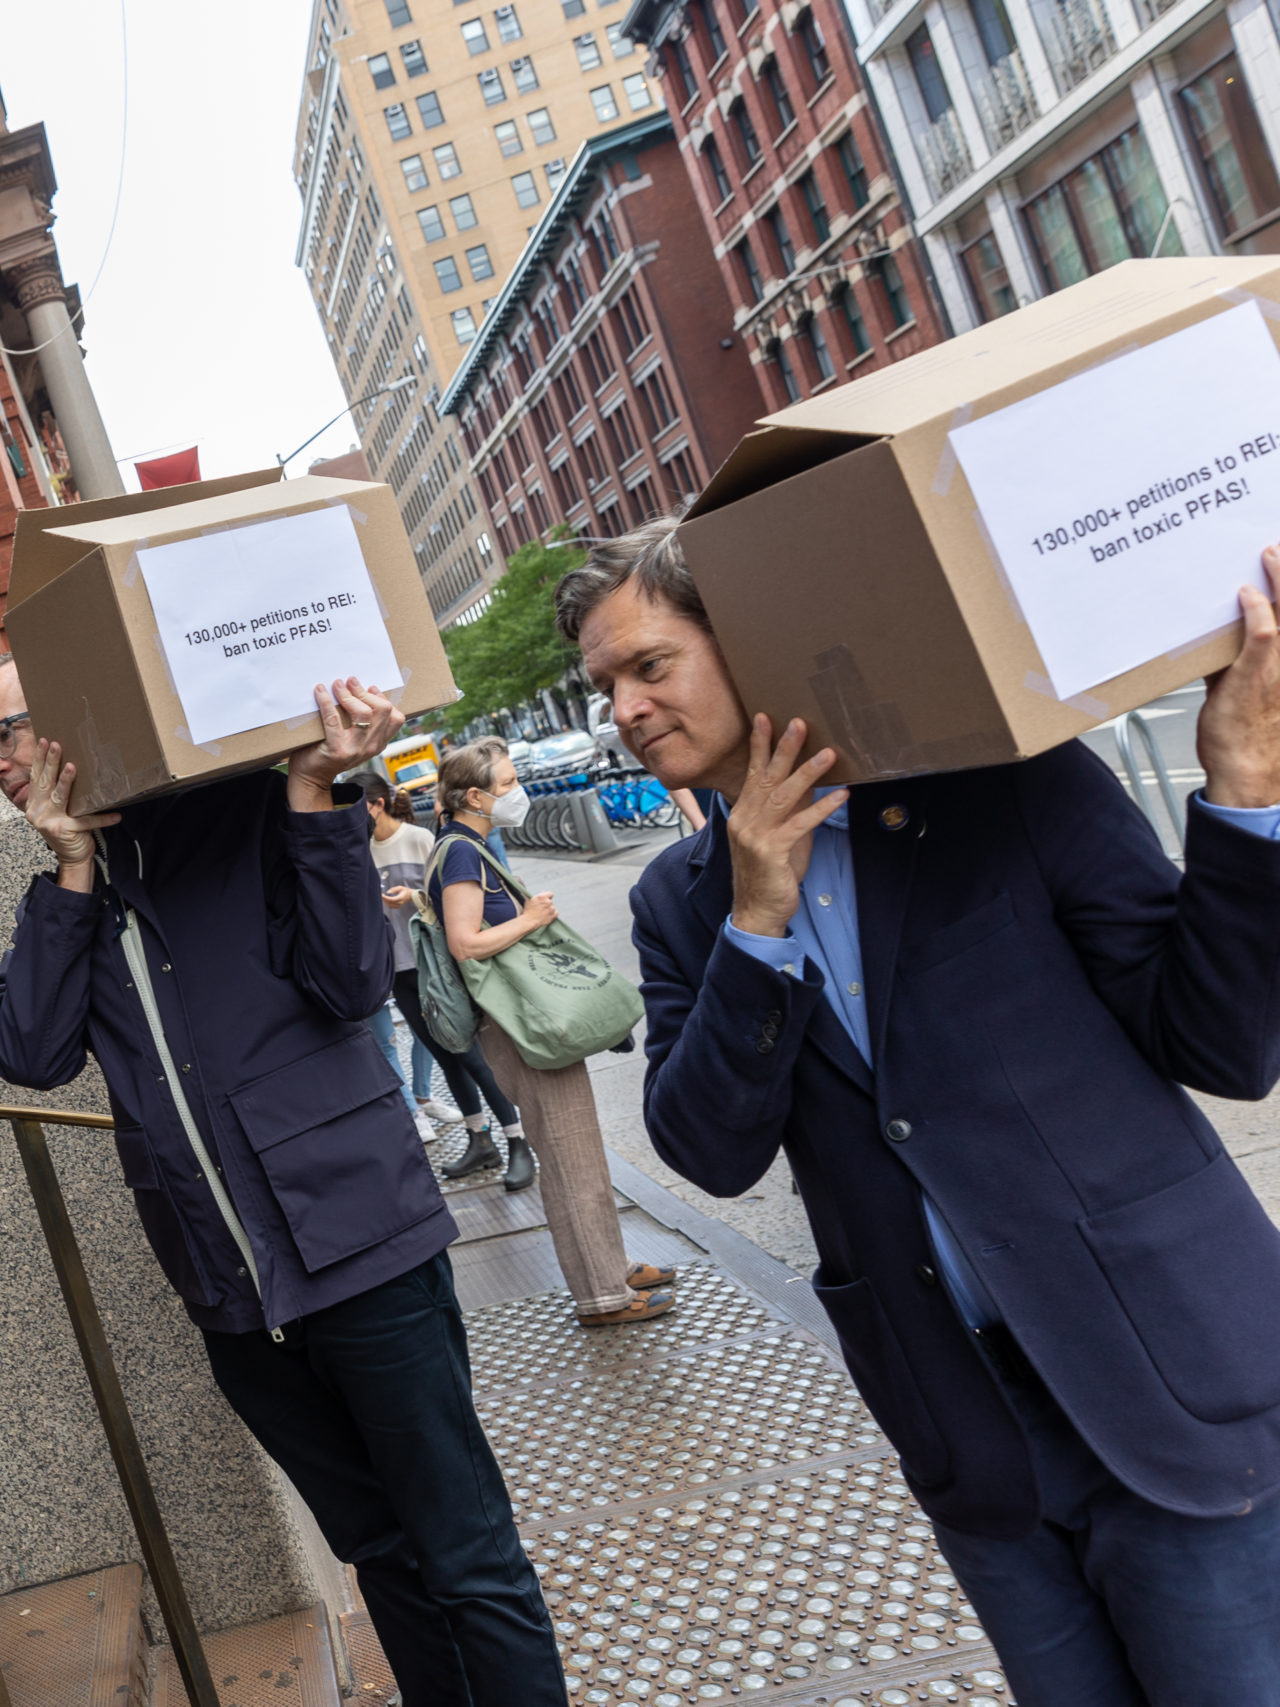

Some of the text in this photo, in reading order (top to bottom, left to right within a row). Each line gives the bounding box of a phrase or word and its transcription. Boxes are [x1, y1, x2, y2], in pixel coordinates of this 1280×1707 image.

[1032, 506, 1122, 556] 130,000+
[1126, 465, 1213, 519] petitions
[1214, 455, 1237, 474] to
[1089, 477, 1251, 563] ban toxic PFAS!
[184, 592, 358, 646] 130,000+ petitions to REI:
[222, 618, 333, 658] ban toxic PFAS!
